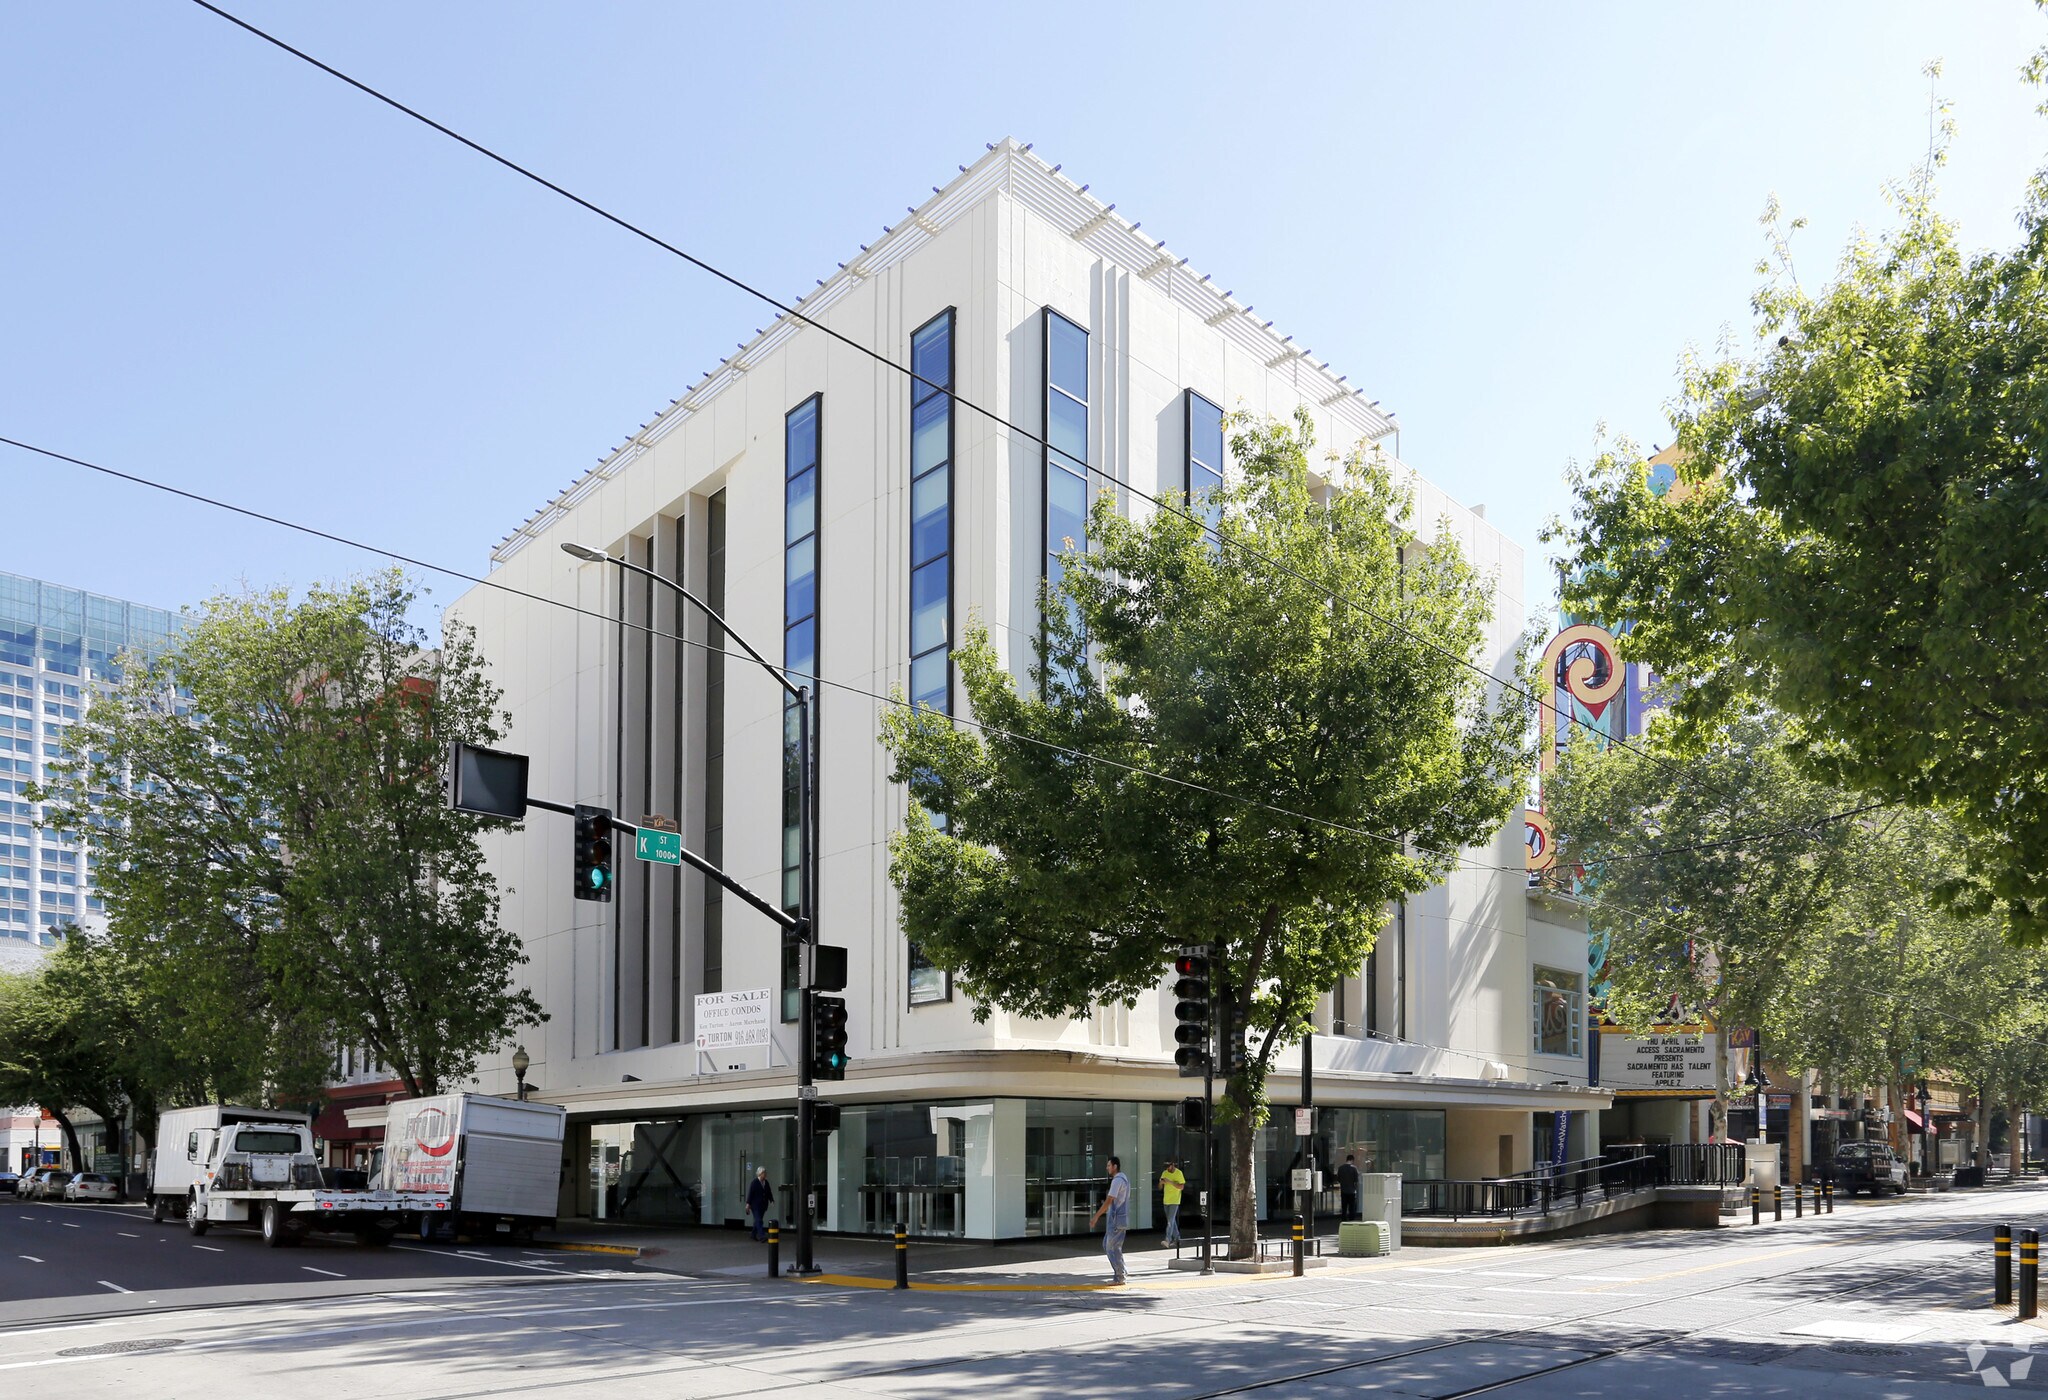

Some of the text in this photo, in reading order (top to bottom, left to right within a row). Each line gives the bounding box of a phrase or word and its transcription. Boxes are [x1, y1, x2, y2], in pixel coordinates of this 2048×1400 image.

[641, 836, 667, 853] K ST
[656, 850, 671, 860] 1000
[697, 991, 769, 1006] FOR SALE
[704, 1005, 761, 1018] OFFICE CONDOS
[708, 1032, 733, 1043] TURTON
[1661, 1037, 1680, 1046] APRIL
[1636, 1046, 1705, 1054] ACCESS SACRAMENTO
[1653, 1054, 1684, 1062] PRESENTS
[1626, 1062, 1712, 1070] SACRAMENTO HAS TALENT
[1651, 1071, 1685, 1079] FEATURING
[1654, 1079, 1681, 1087] APPLE Z
